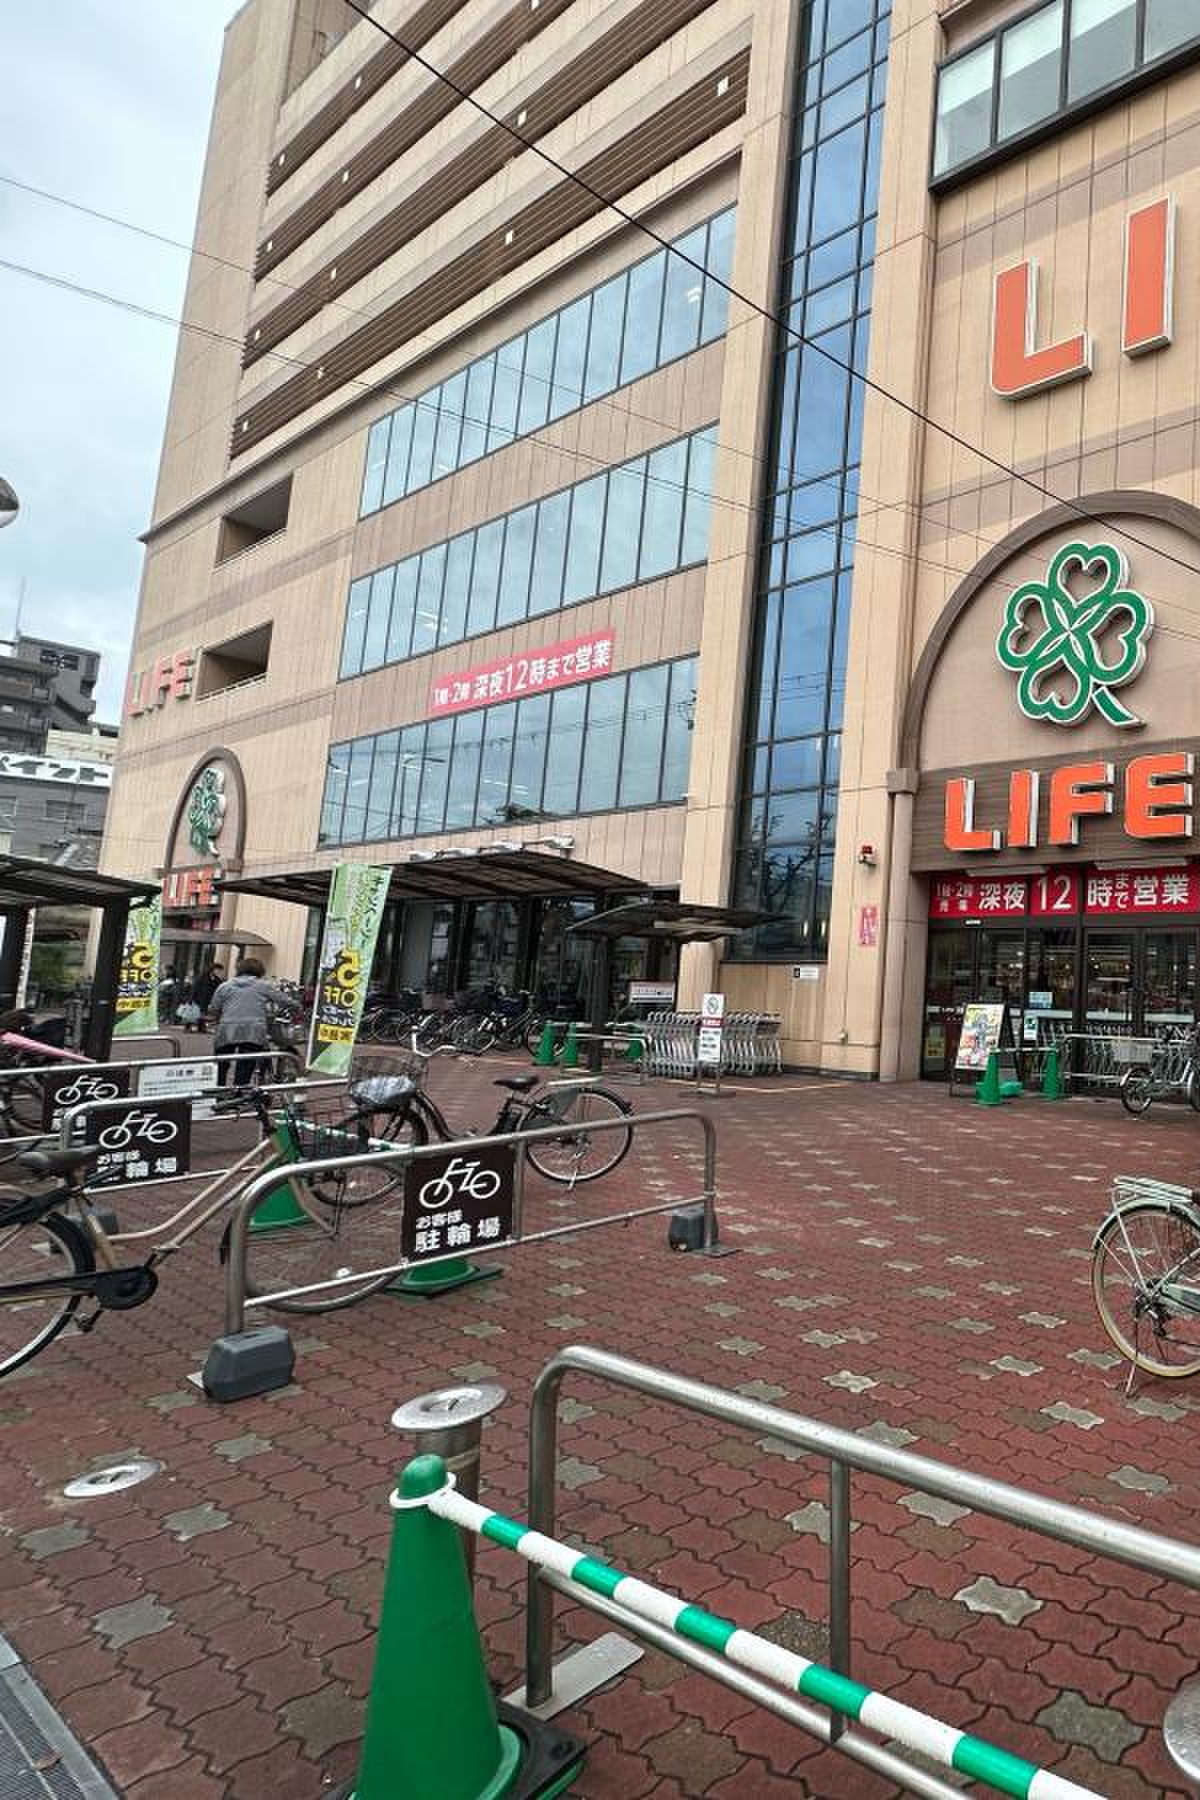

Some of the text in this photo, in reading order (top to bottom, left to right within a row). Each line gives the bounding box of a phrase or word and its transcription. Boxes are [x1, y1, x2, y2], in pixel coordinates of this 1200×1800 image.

[127, 652, 196, 716] LIFE
[943, 751, 1195, 851] LIFE
[162, 863, 224, 908] LIFE
[979, 873, 1189, 911] 深夜12時まで営業
[414, 1216, 500, 1253] 駐輪場
[416, 1209, 463, 1230] お客様
